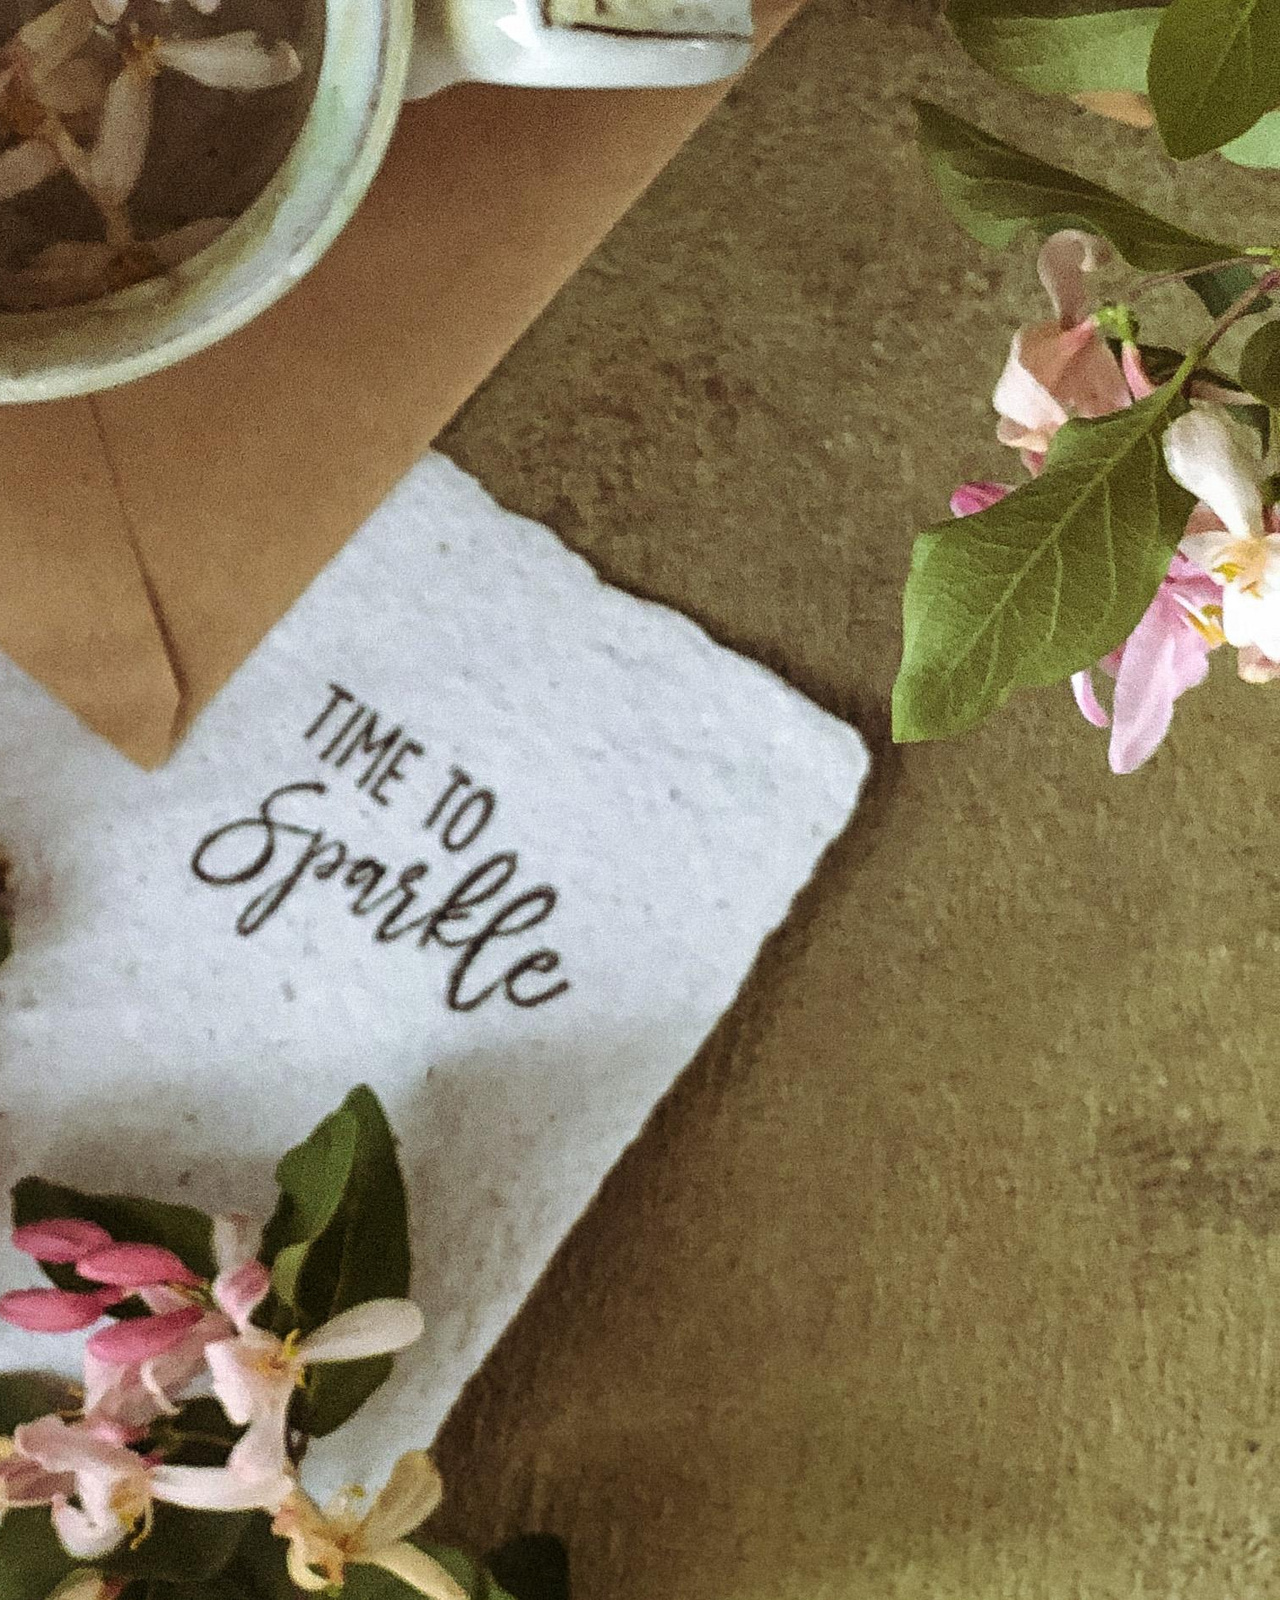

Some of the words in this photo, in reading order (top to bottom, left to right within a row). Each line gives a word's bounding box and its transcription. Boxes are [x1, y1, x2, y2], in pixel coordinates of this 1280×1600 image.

[303, 681, 425, 807] TIME
[422, 763, 497, 853] TO
[190, 781, 571, 1013] Sparkle
